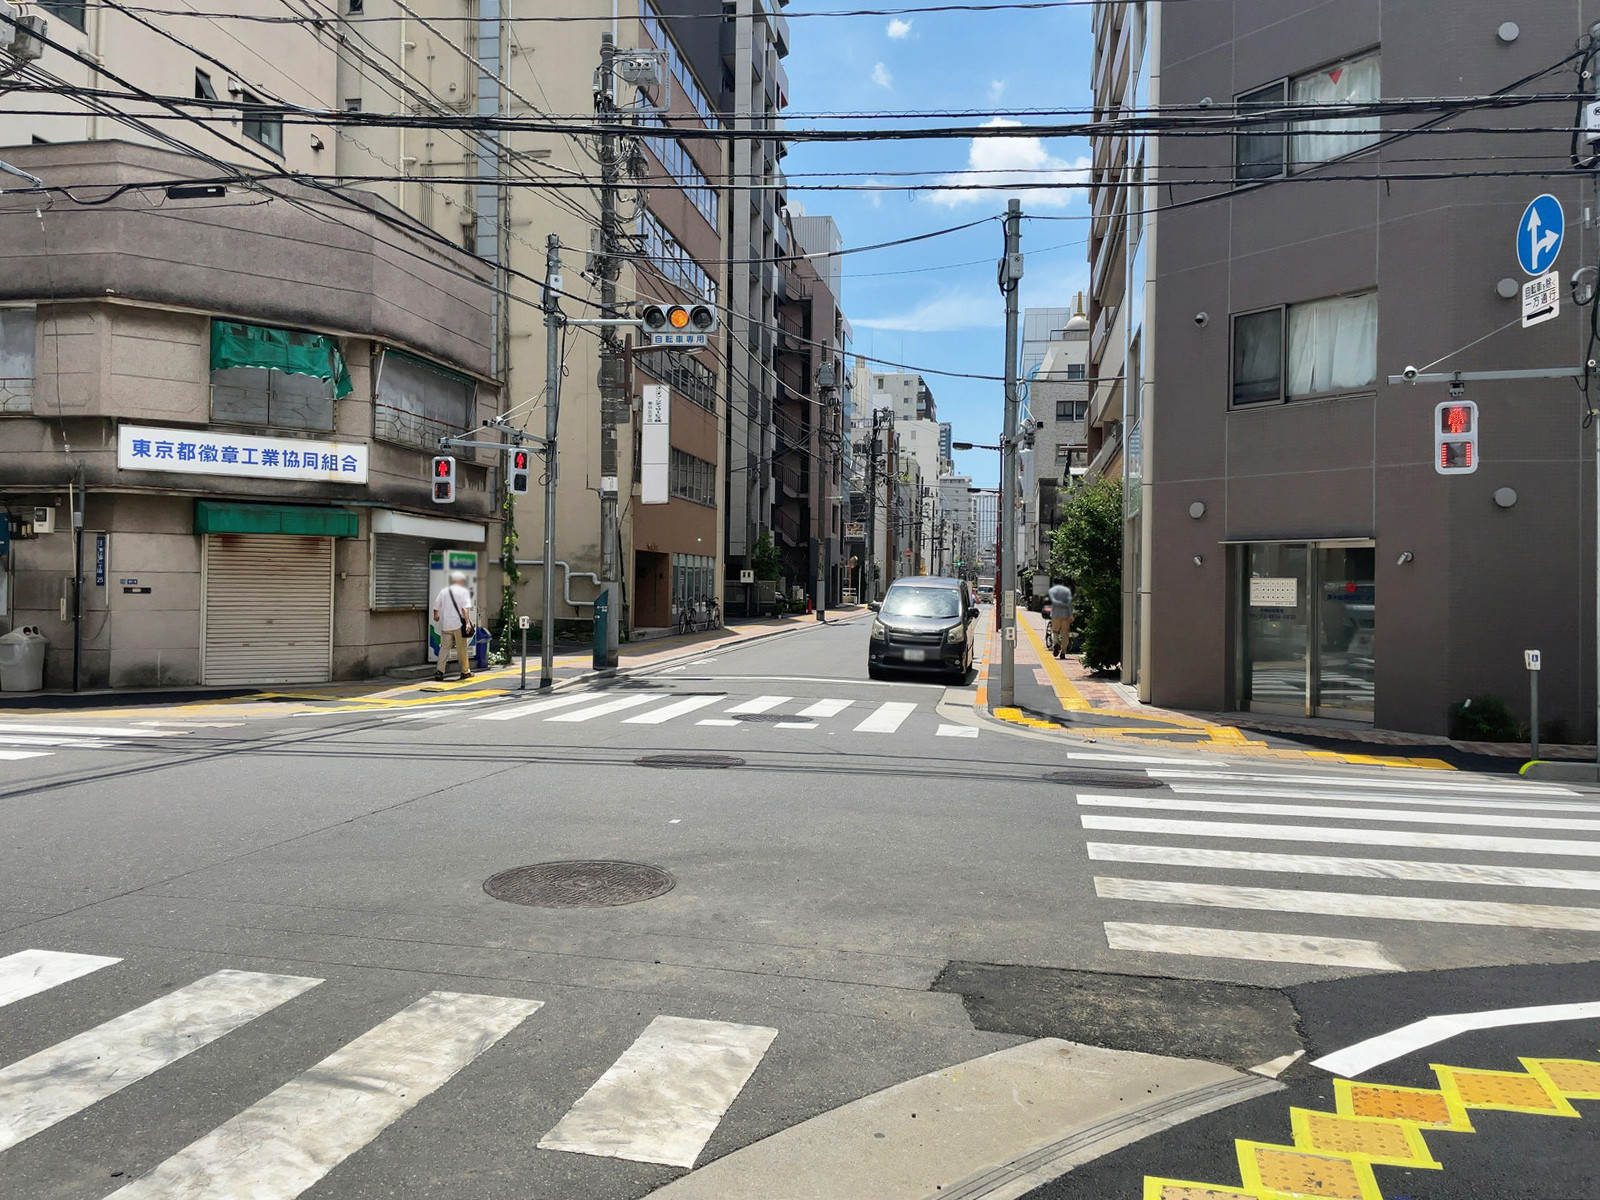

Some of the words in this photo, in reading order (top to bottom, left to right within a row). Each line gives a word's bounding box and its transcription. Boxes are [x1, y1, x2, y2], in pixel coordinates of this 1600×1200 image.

[1525, 288, 1556, 309] 一方通行
[654, 335, 705, 344] 自転車専用
[131, 438, 359, 473] 東京都徽章工業協同組合
